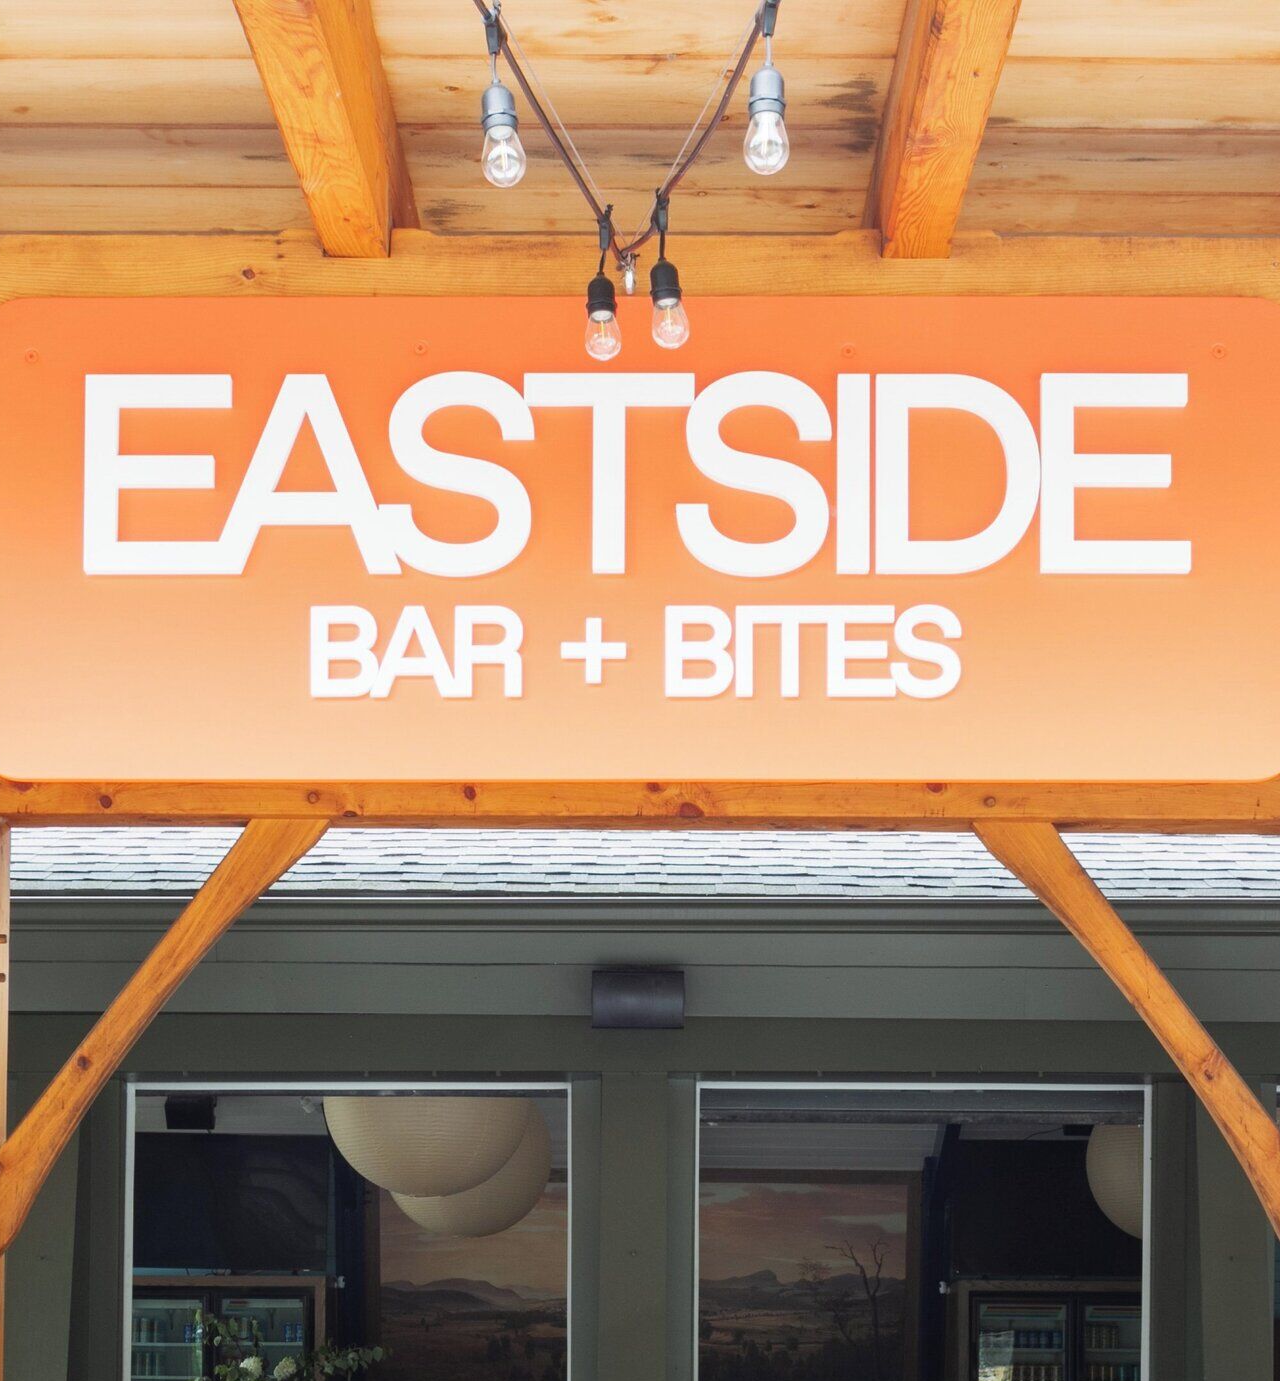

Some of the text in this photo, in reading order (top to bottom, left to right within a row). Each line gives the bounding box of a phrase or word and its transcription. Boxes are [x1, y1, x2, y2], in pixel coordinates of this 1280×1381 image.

[83, 371, 1192, 577] EASTSIDE
[309, 604, 962, 698] BAR + BITES
